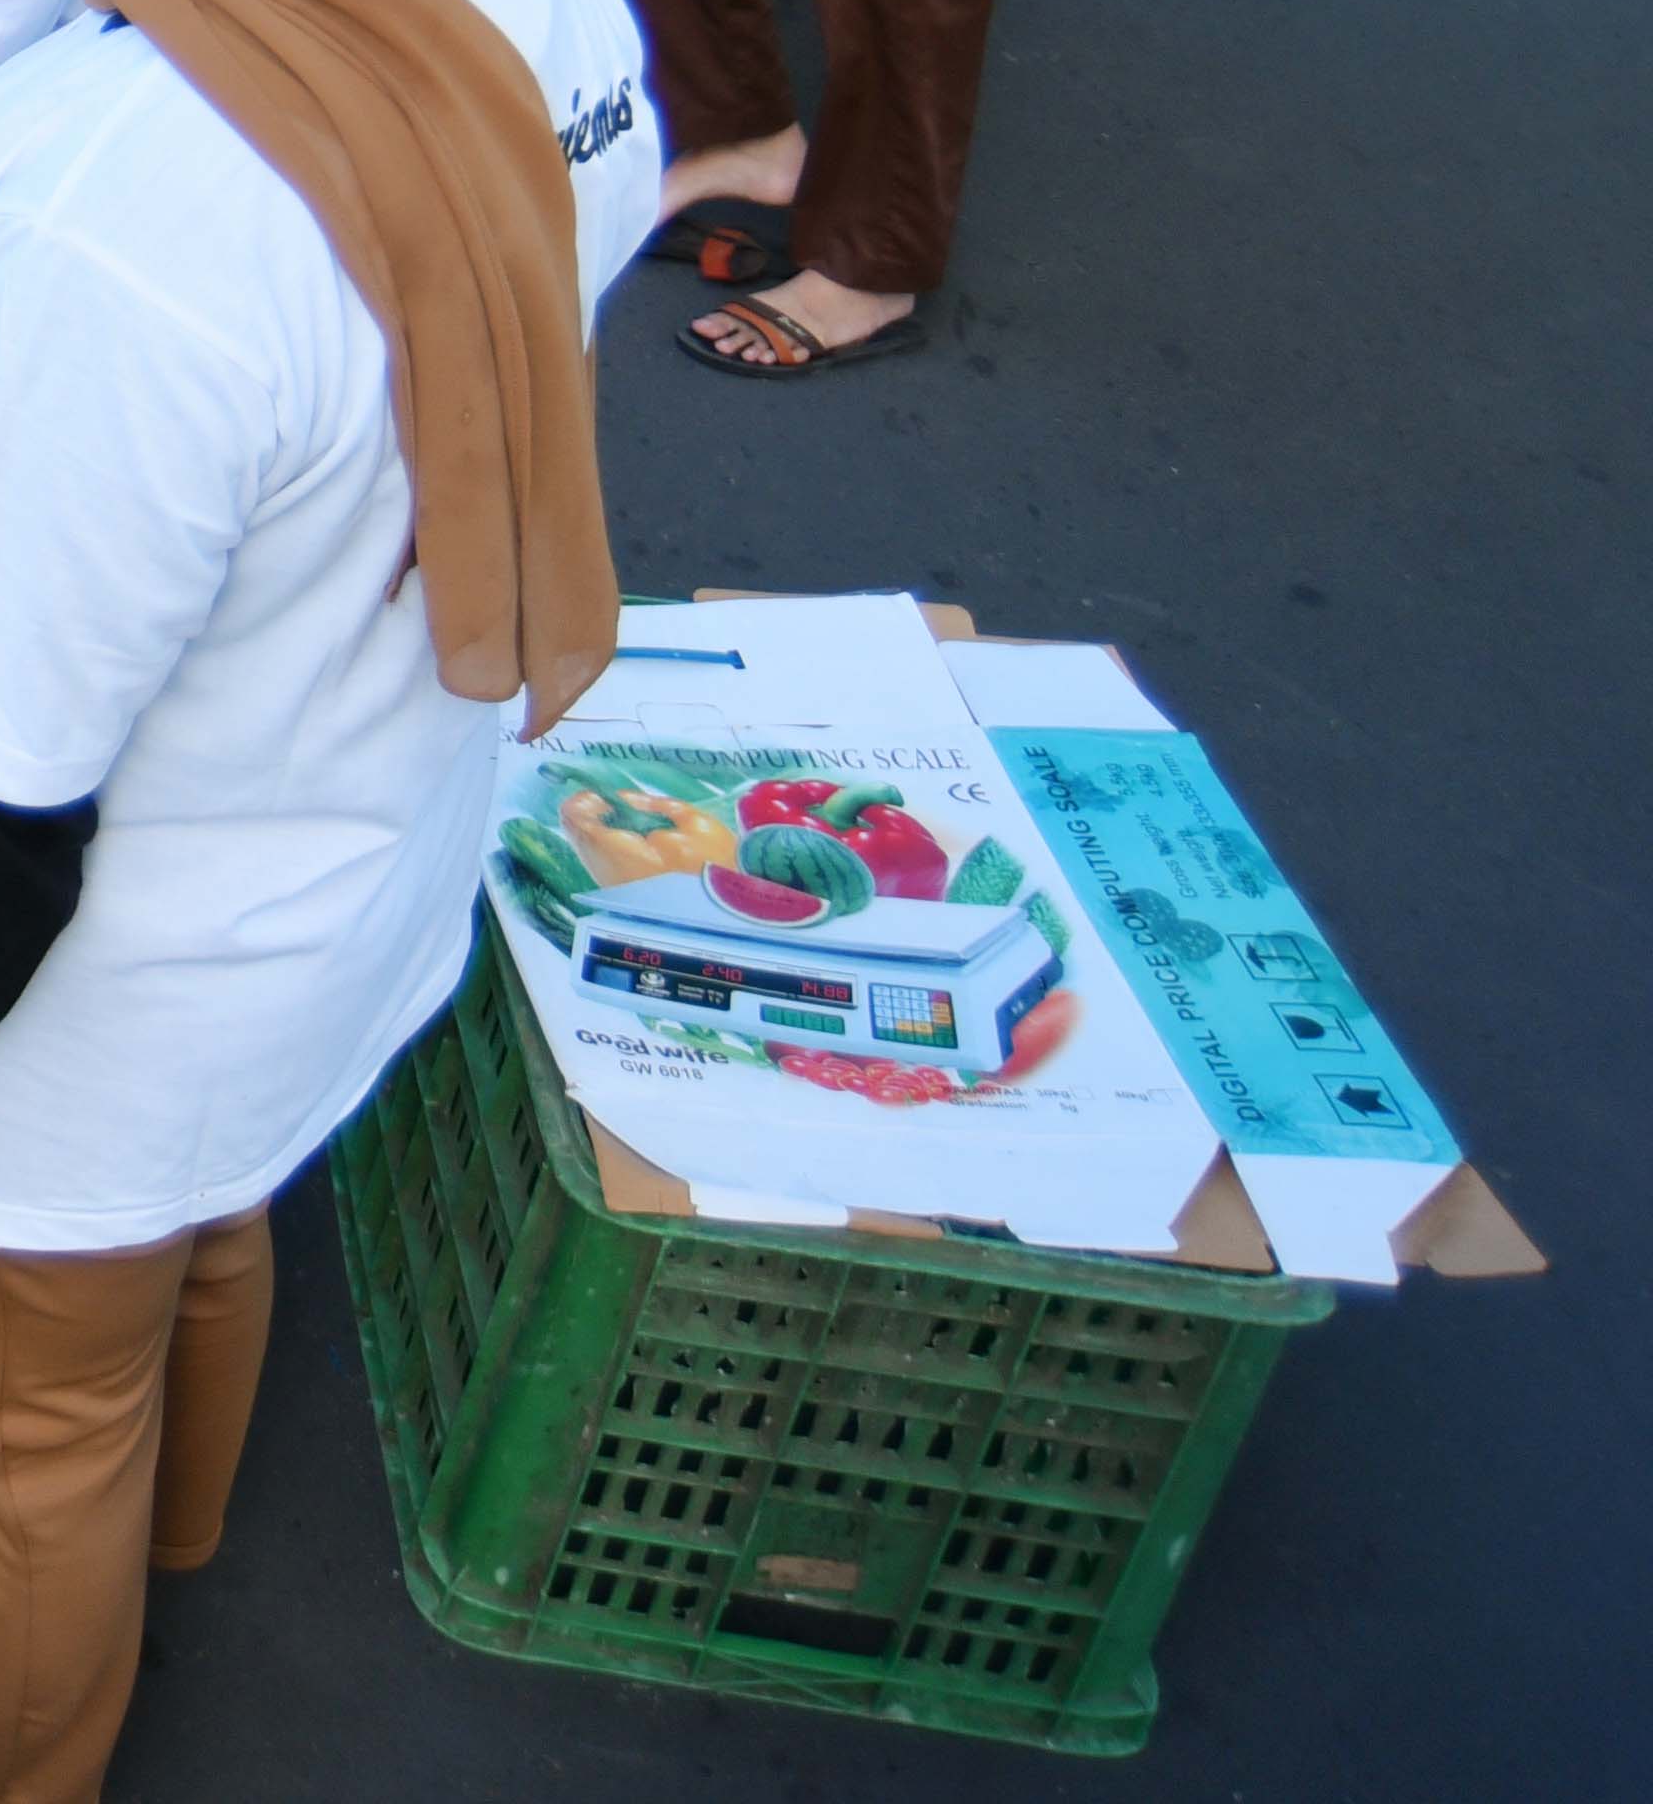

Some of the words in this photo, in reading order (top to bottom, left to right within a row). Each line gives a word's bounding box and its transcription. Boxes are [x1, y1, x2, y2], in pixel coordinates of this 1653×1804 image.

[579, 739, 665, 763] PRICE
[674, 747, 866, 770] COMPUTING
[872, 747, 971, 771] SCALE
[1067, 821, 1158, 947] COMPUTING
[1165, 859, 1198, 898] Gross
[623, 946, 662, 967] 6.20
[702, 963, 743, 983] 2.40
[1144, 952, 1205, 1023] PRICE
[575, 1028, 651, 1056] Good
[654, 1045, 729, 1065] wife
[620, 1059, 653, 1075] GW
[1197, 1029, 1267, 1124] DIGITAL
